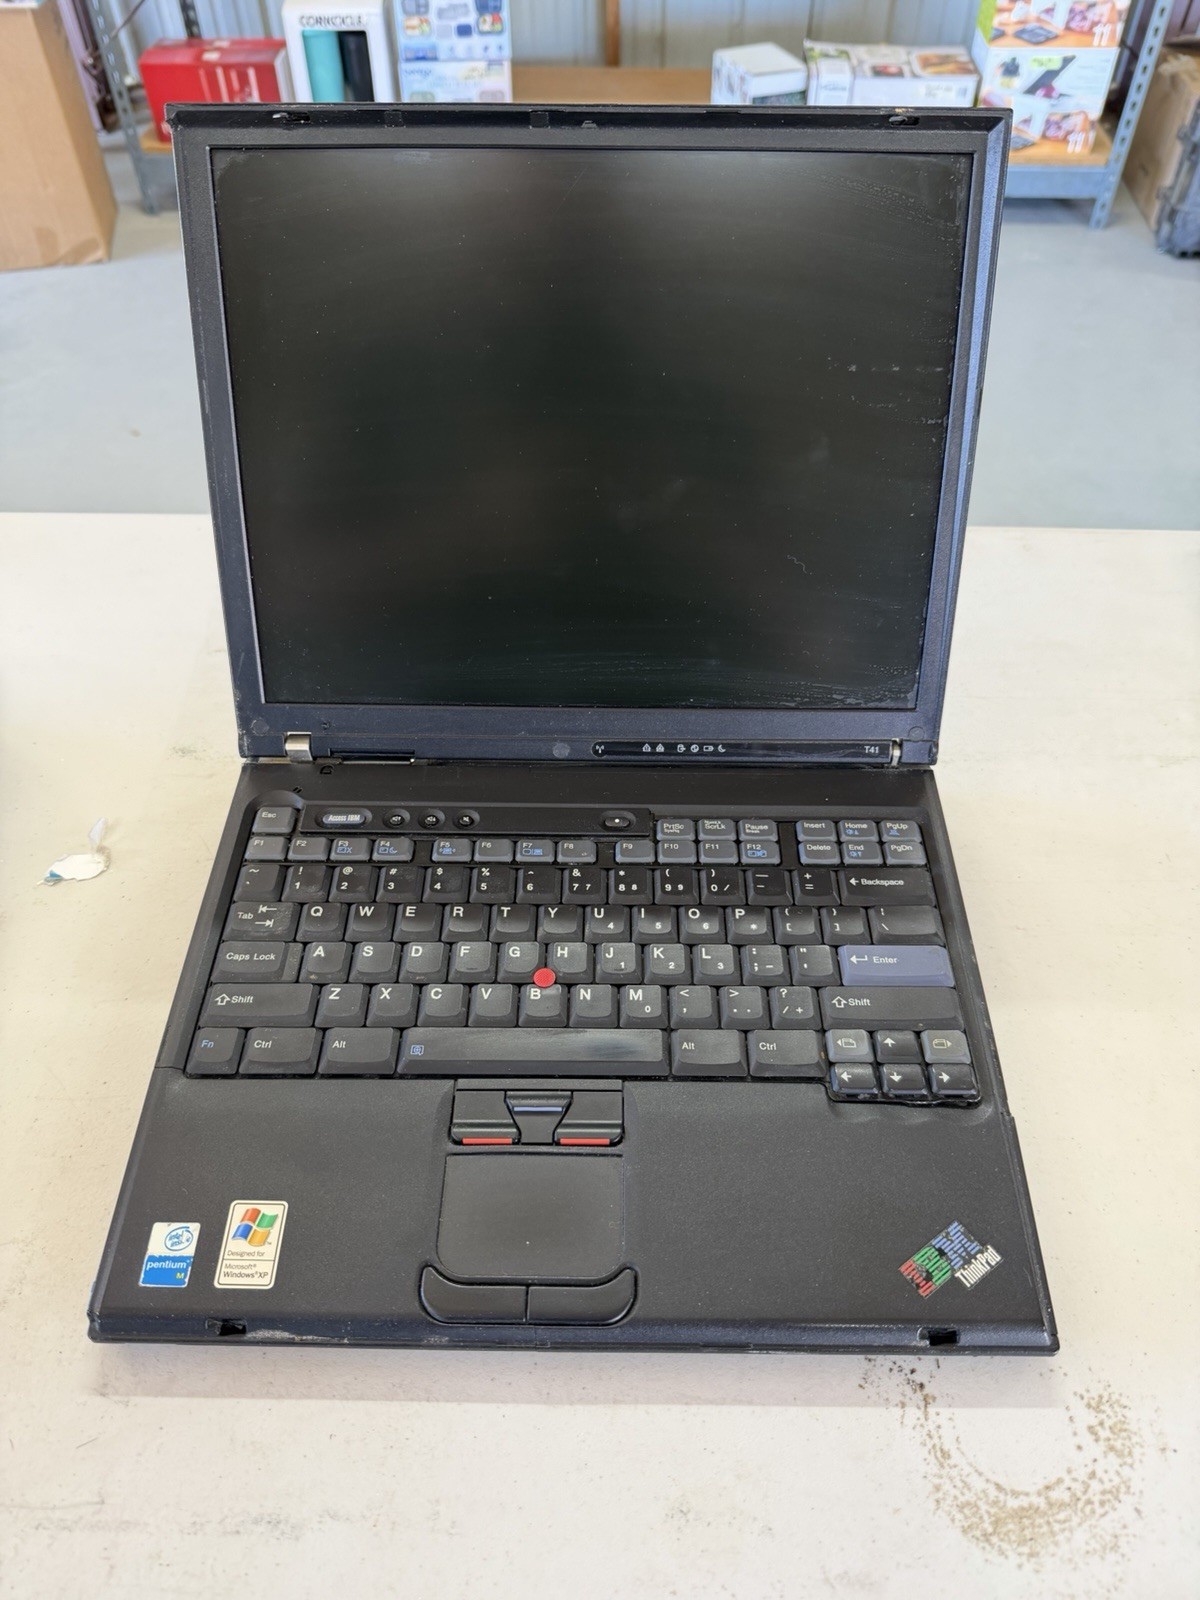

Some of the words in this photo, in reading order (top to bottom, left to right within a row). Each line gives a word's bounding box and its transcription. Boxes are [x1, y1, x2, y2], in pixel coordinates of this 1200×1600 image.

[864, 746, 879, 754] T41
[298, 867, 304, 875] !
[342, 866, 354, 876] @
[436, 868, 443, 876] $
[482, 868, 490, 876] %
[572, 868, 582, 876] &
[666, 868, 670, 877] (
[710, 868, 716, 877] )
[434, 882, 442, 890] 4
[480, 882, 488, 890] 5
[526, 882, 534, 891] 6
[572, 883, 580, 891] 7
[860, 878, 904, 887] Backspace
[618, 884, 626, 892] 8
[664, 884, 672, 892] 9
[710, 884, 718, 892] 0
[237, 912, 254, 920] Tab
[310, 906, 324, 918] Q
[358, 906, 374, 917] W
[405, 906, 416, 917] E
[452, 906, 464, 918] R
[500, 907, 512, 918] T
[548, 907, 558, 918] Y
[594, 908, 604, 918] U
[640, 908, 645, 918] I
[688, 908, 700, 919] O
[734, 908, 746, 920] P
[226, 952, 250, 961] Caps
[253, 952, 276, 960] Lock
[312, 946, 326, 958] A
[362, 946, 374, 958] S
[410, 946, 422, 957] D
[460, 946, 471, 957] F
[508, 946, 520, 958] G
[556, 946, 568, 958] H
[605, 948, 614, 958] J
[653, 948, 664, 959] K
[702, 948, 712, 959] L
[328, 988, 342, 1000] Z
[380, 988, 392, 1000] X
[430, 988, 442, 1000] C
[480, 988, 492, 1000] V
[530, 988, 541, 1000] B
[579, 988, 592, 1000] N
[629, 988, 643, 1000] M
[780, 988, 788, 998] ?
[230, 995, 254, 1004] Shift
[848, 998, 870, 1006] Shift
[644, 1005, 652, 1013] 0
[201, 1040, 214, 1048] Fn
[254, 1039, 272, 1048] Ctrl
[332, 1040, 346, 1048] Alt
[681, 1041, 695, 1050] Alt
[759, 1042, 777, 1050] Ctrl
[227, 1250, 256, 1258] Designed
[898, 1221, 984, 1297] IBM
[146, 1260, 187, 1271] pentium
[954, 1244, 1002, 1288] ThinkPad
